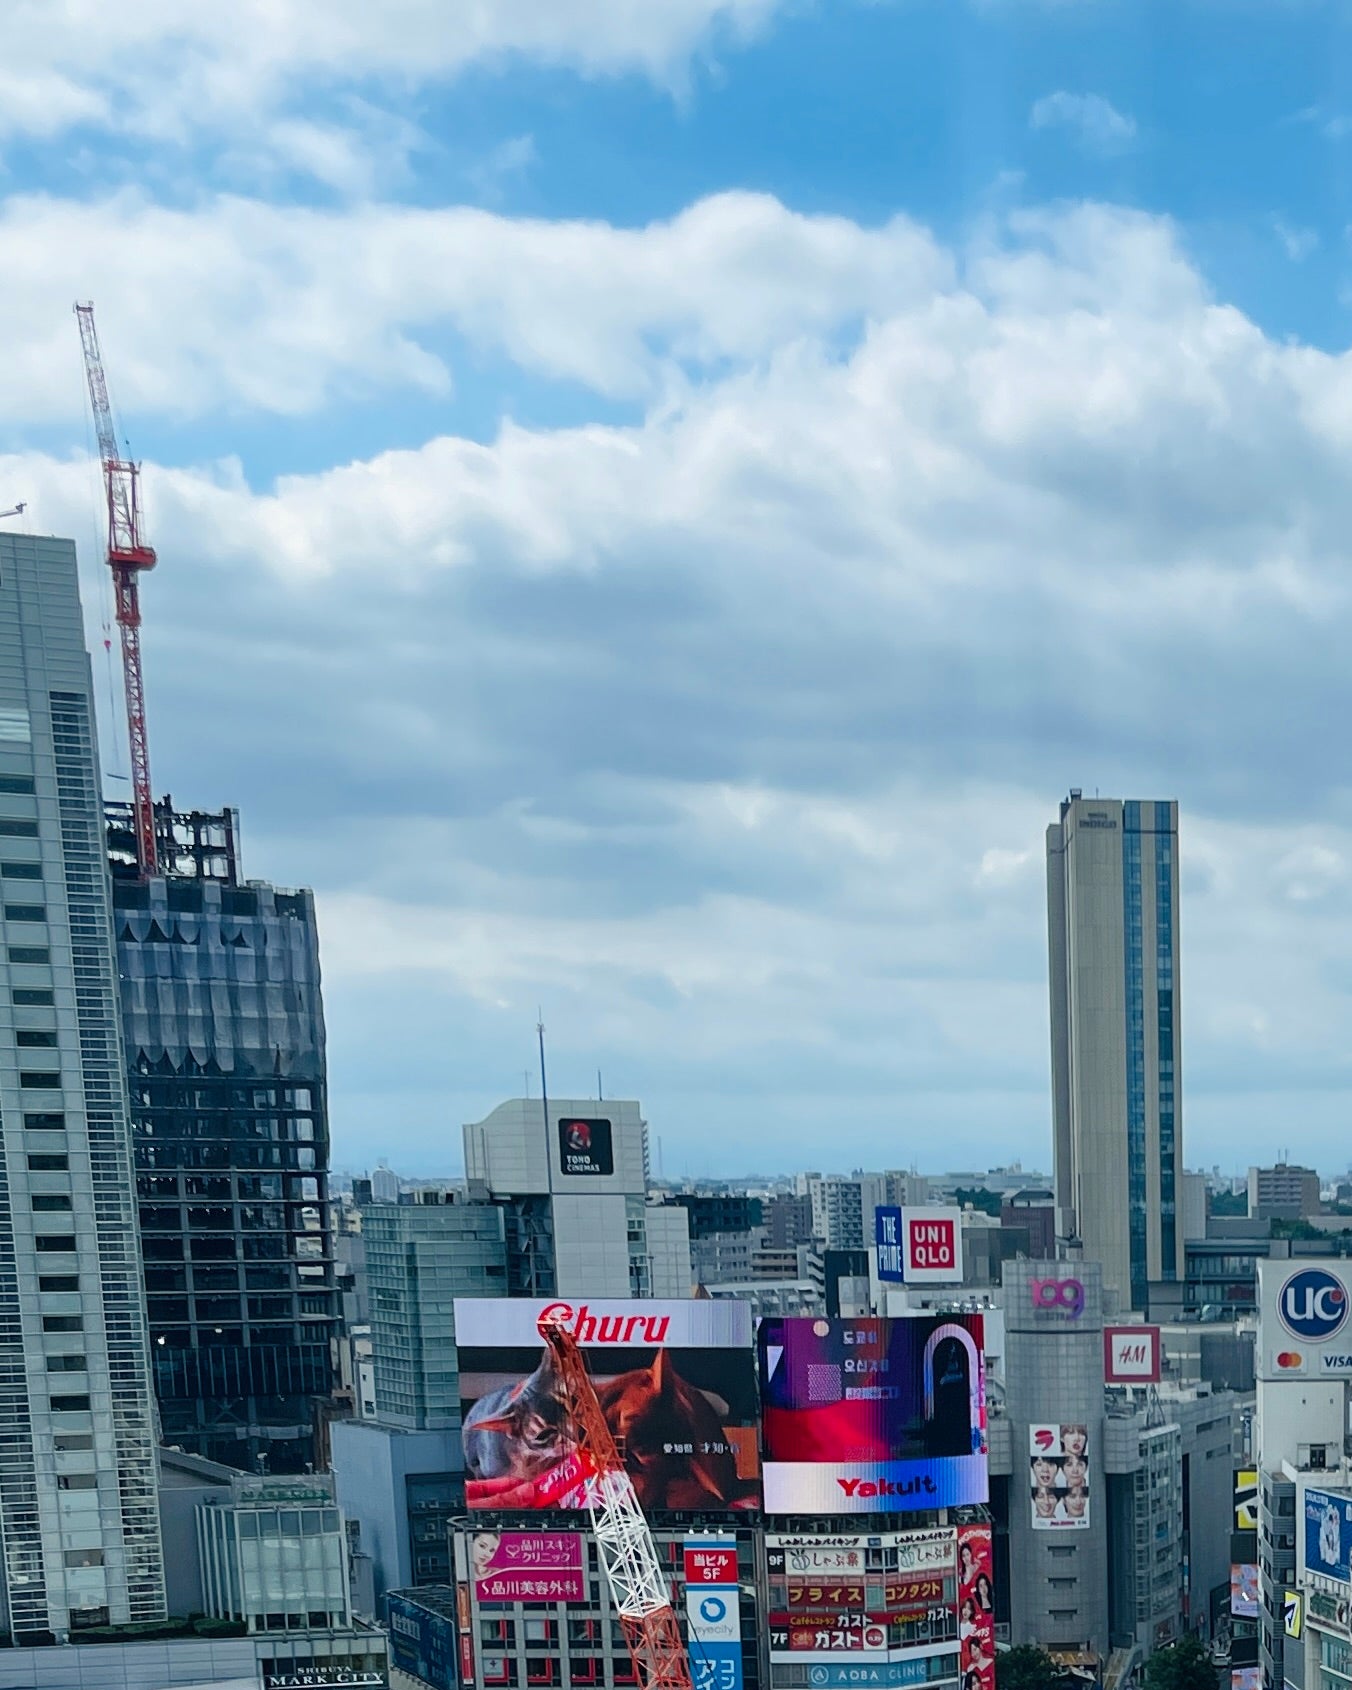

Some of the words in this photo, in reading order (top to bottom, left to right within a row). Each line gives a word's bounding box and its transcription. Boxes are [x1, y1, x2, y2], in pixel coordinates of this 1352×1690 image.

[567, 1155, 590, 1164] TOHO
[882, 1216, 896, 1243] THE
[914, 1226, 946, 1243] UNI
[878, 1246, 901, 1272] PRIME
[915, 1247, 950, 1265] QLO
[1027, 1278, 1085, 1321] 109
[1119, 1345, 1146, 1364] H&M
[837, 1475, 937, 1497] Yakult
[779, 1537, 860, 1546] しゃぶしゃぶバイキング
[522, 1553, 570, 1563] クリニック
[769, 1555, 783, 1566] 9F
[703, 1567, 721, 1580] 5F
[491, 1581, 578, 1596] 品川美容外科
[886, 1582, 941, 1601] コンタクト
[838, 1614, 873, 1628] ガスト
[928, 1607, 952, 1621] ガスト
[771, 1633, 787, 1644] 7F
[815, 1631, 860, 1649] ガスト
[297, 1666, 351, 1674] SHIBUYA
[838, 1670, 879, 1680] AOBA
[889, 1664, 926, 1680] CLINIC
[270, 1674, 328, 1686] MARK
[337, 1672, 384, 1683] CITY
